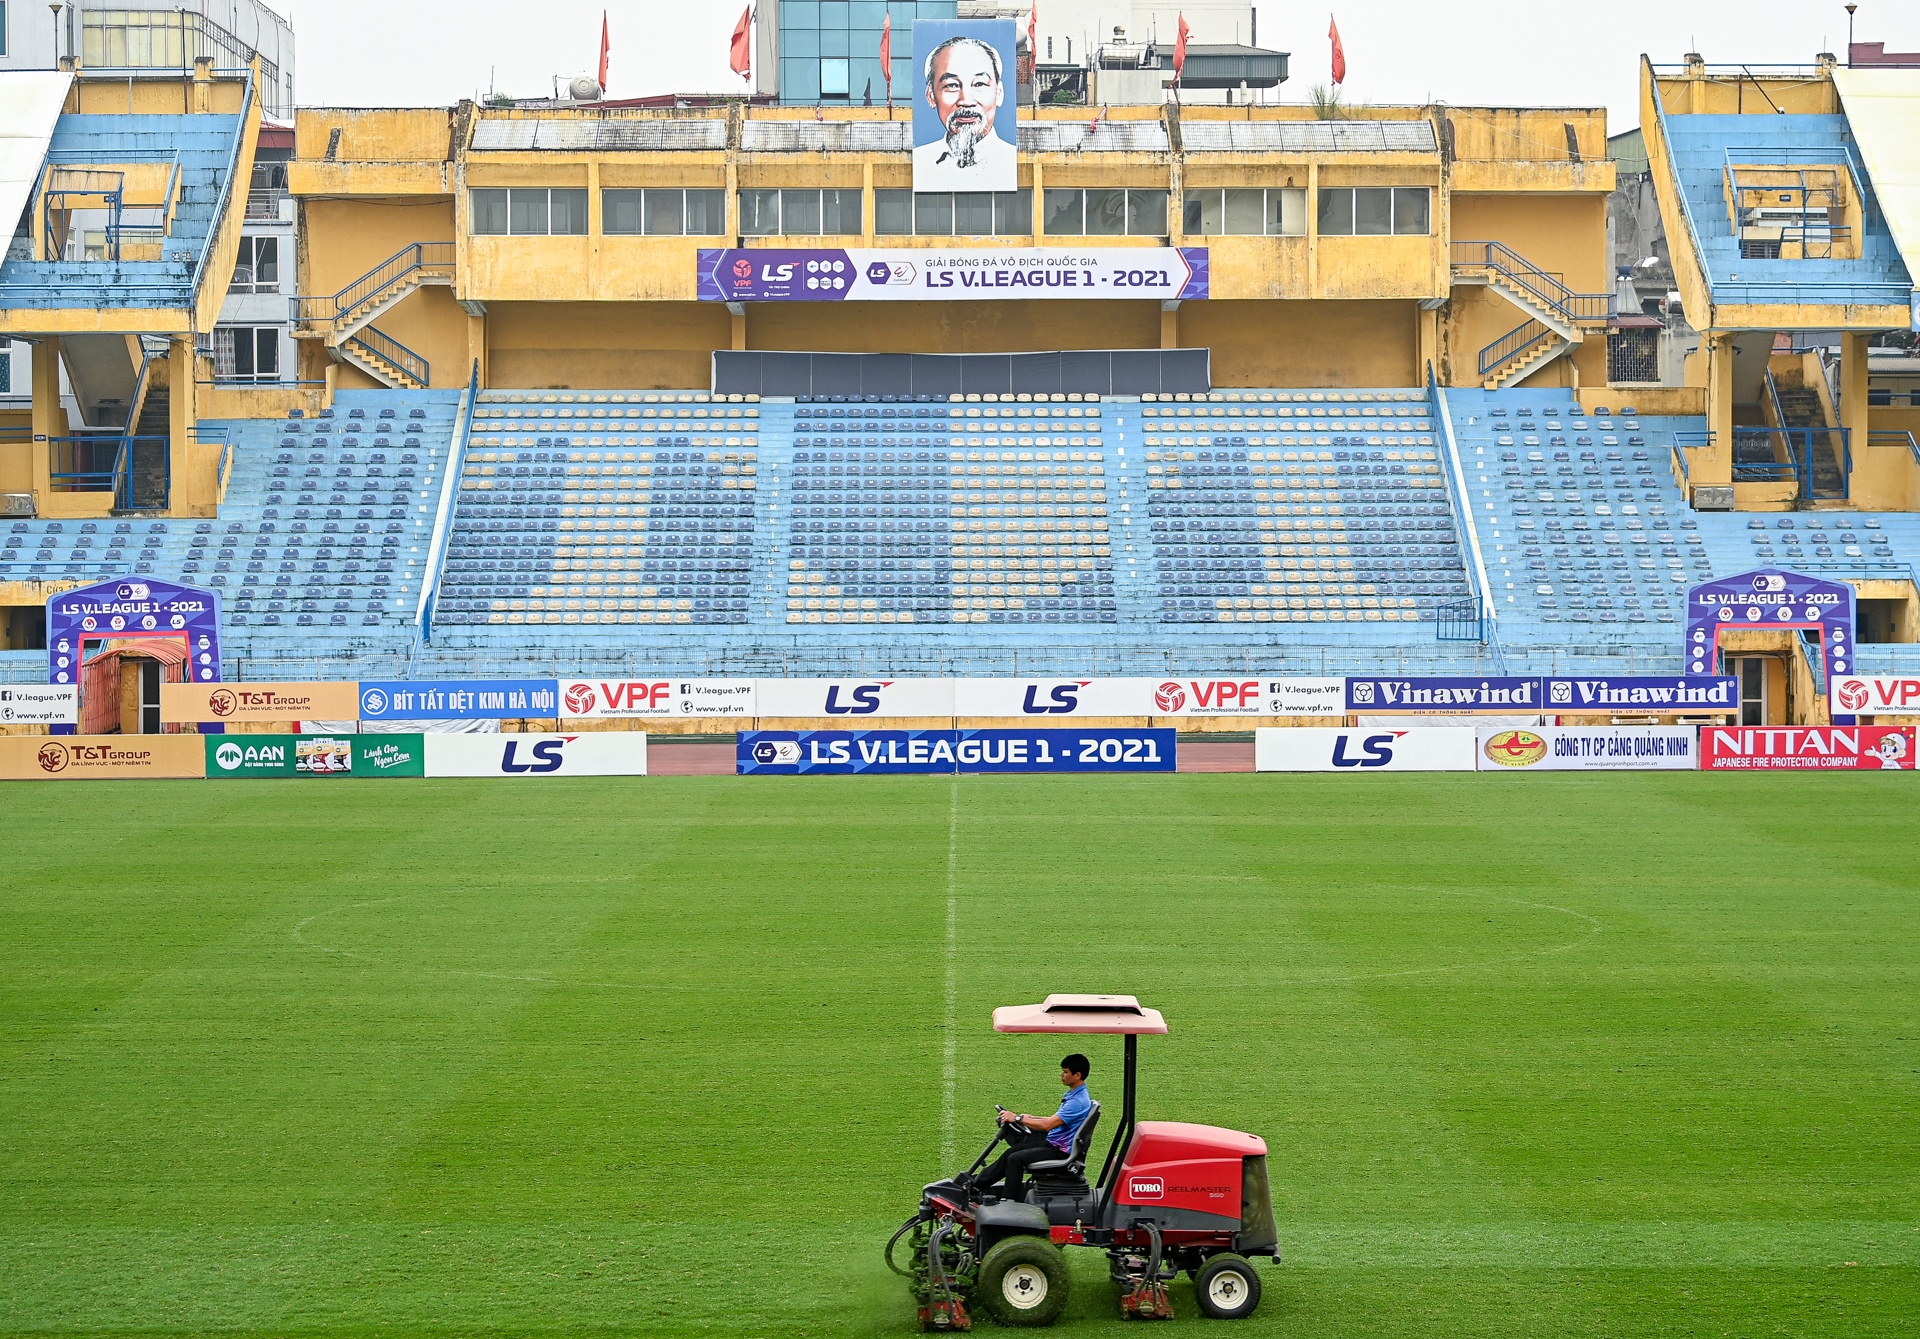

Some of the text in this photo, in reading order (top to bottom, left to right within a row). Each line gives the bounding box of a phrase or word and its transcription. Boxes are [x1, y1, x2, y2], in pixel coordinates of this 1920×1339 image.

[926, 257, 946, 267] GIẢI
[950, 258, 979, 267] BÓNG
[983, 258, 997, 266] ĐÁ
[1001, 257, 1015, 266] VÔ
[1019, 259, 1043, 267] ĐỊCH
[1047, 255, 1076, 266] QUỐC
[762, 264, 793, 281] LS
[870, 269, 885, 278] LS
[927, 272, 953, 287] LS
[960, 270, 1076, 287] V.LEAGUE
[1083, 271, 1095, 286] 1
[1114, 271, 1170, 286] 2021
[1700, 594, 1716, 604] LS
[1719, 594, 1786, 604] V.LEAGUE
[1789, 594, 1796, 604] 1
[1806, 594, 1839, 604] 2021
[63, 604, 79, 615] LS
[82, 603, 150, 614] V.LEAGUE
[153, 603, 160, 612] 1
[170, 602, 204, 612] 2021
[17, 694, 72, 702] V.league.VPF
[239, 692, 275, 704] T&T
[600, 683, 669, 708] VPF
[696, 687, 751, 695] V.league.VPF
[1190, 682, 1259, 707] VPF
[1285, 686, 1340, 695] V.league.VPF
[1874, 680, 1920, 705] VP
[394, 688, 554, 713] BÍT TẤT DỆT KIM HÀ NỘI
[825, 686, 880, 714] LS
[1023, 685, 1078, 714] LS
[696, 705, 744, 713] www.vpf.vn
[1285, 704, 1333, 712] www.vpf.vn
[17, 712, 64, 720] www.vpf.vn
[1555, 731, 1688, 758] CÔNG TY CP CẢNG QUẢNG NINH
[1713, 729, 1858, 755] NITTAN
[71, 746, 111, 759] T&T
[502, 741, 564, 772] LS
[811, 740, 850, 764] LS
[858, 740, 1028, 764] V.LEAGUE
[1036, 740, 1054, 763] 1
[1079, 739, 1161, 763] 2021
[1332, 736, 1394, 767] LS
[1713, 756, 1858, 768] JAPANESE FIRE PROTECTION COMPANY
